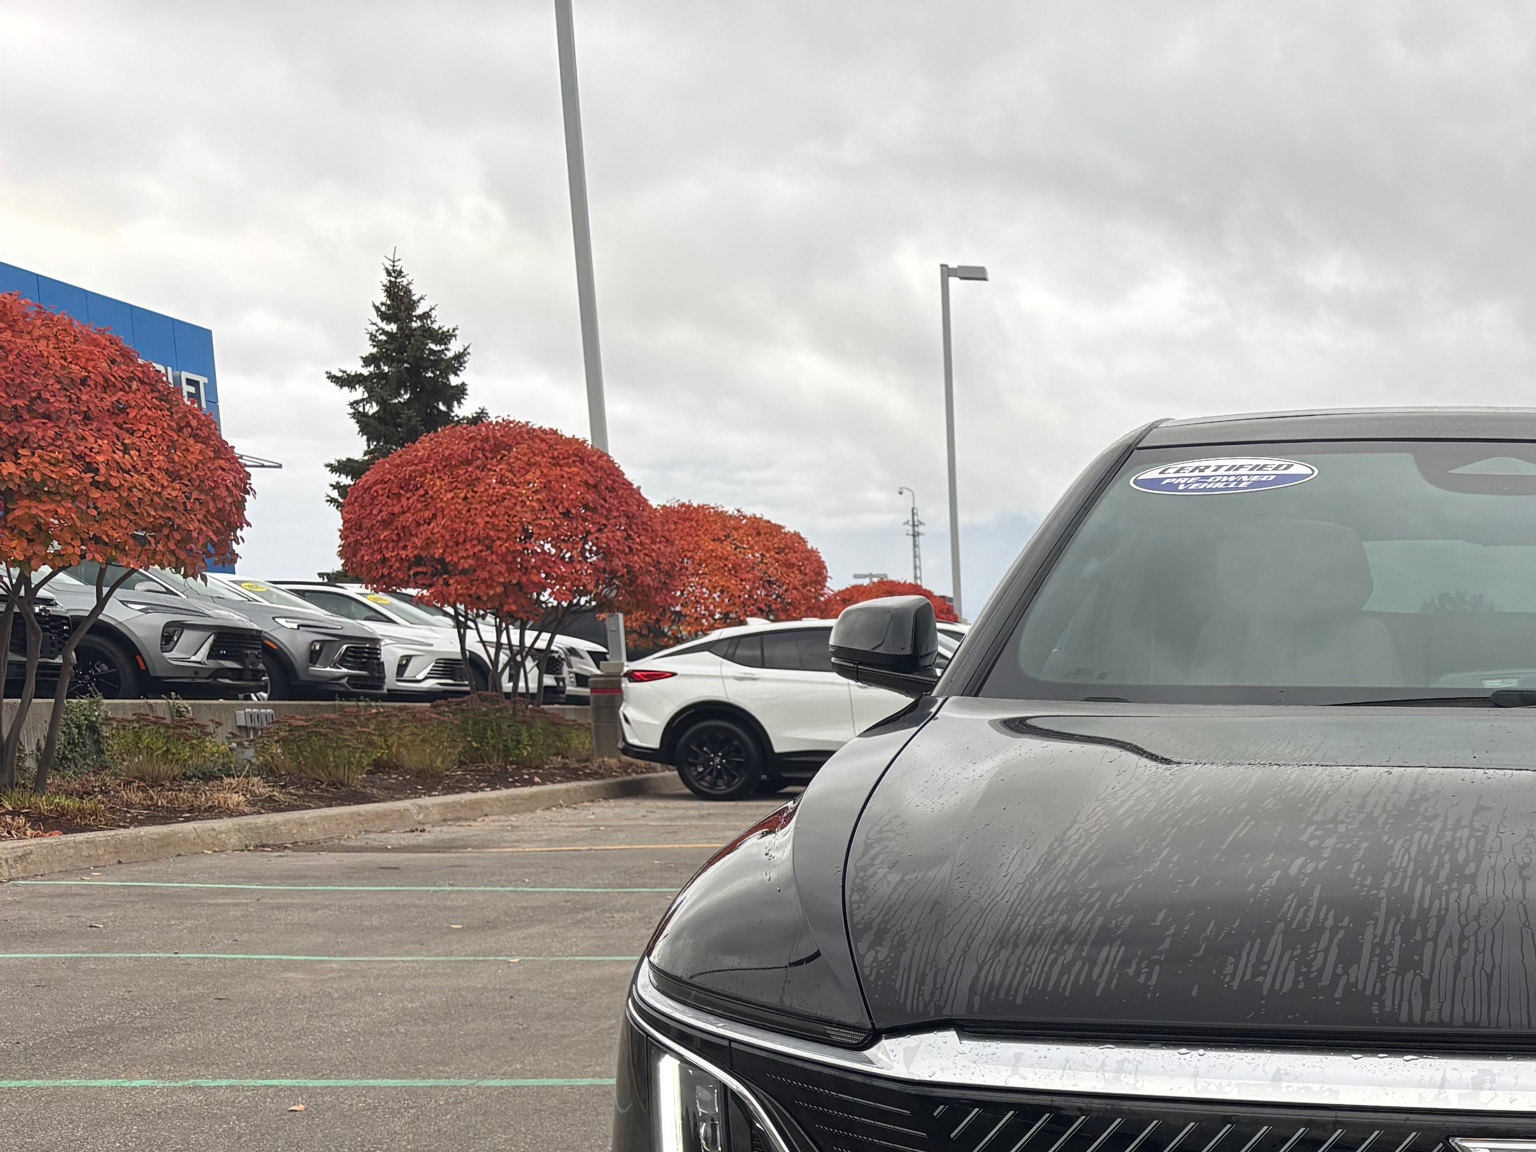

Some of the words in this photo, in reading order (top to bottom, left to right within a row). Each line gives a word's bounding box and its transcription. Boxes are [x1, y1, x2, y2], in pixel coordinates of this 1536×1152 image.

[1158, 463, 1295, 475] CERTIFIED
[1161, 475, 1277, 485] PRE-OWNED
[1177, 482, 1253, 490] VEHICLE
